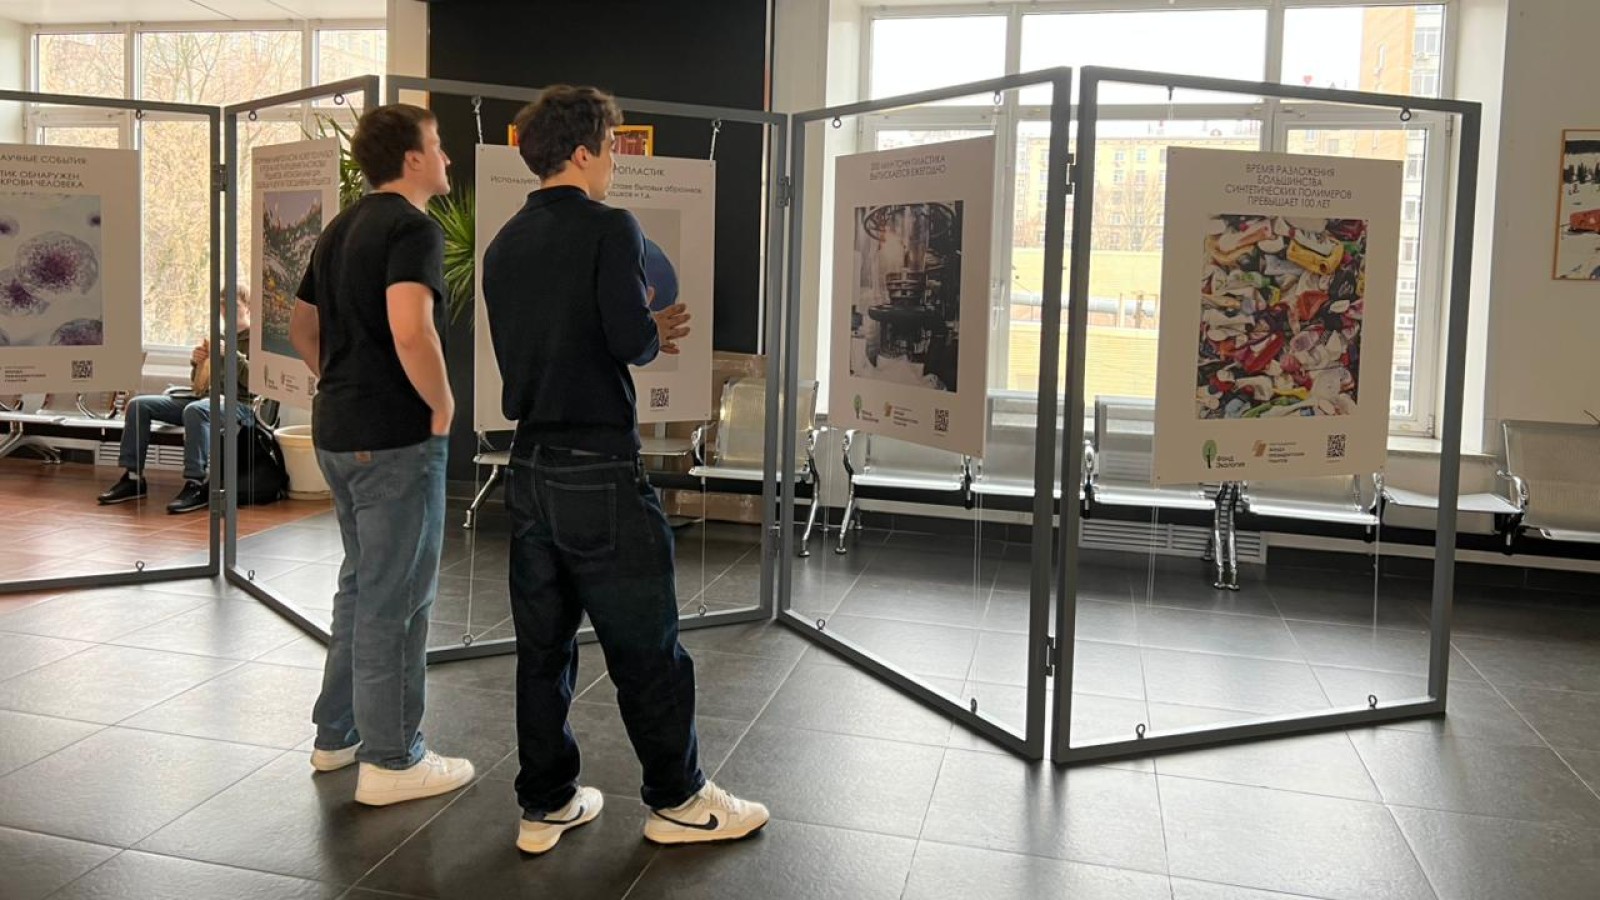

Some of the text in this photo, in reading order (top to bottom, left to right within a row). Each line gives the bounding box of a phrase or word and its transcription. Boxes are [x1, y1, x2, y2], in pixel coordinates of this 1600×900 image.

[0, 155, 86, 165] АУЧНЫЕ СОБЫТИЯ
[20, 170, 80, 180] ОБНАРУЖЕН
[1246, 164, 1336, 177] ВРЕМЯ РАЗЛОЖЕНИЯ
[37, 179, 84, 188] ЧЕЛОВЕКА
[1257, 175, 1322, 187] БОЛЬШИНСТВА
[1225, 184, 1352, 200] СИНТЕТИЧЕСКИХ ПОЛИМЕРОВ
[1248, 196, 1331, 209] ПРЕВЫШАЕТ 100 ЛЕТ
